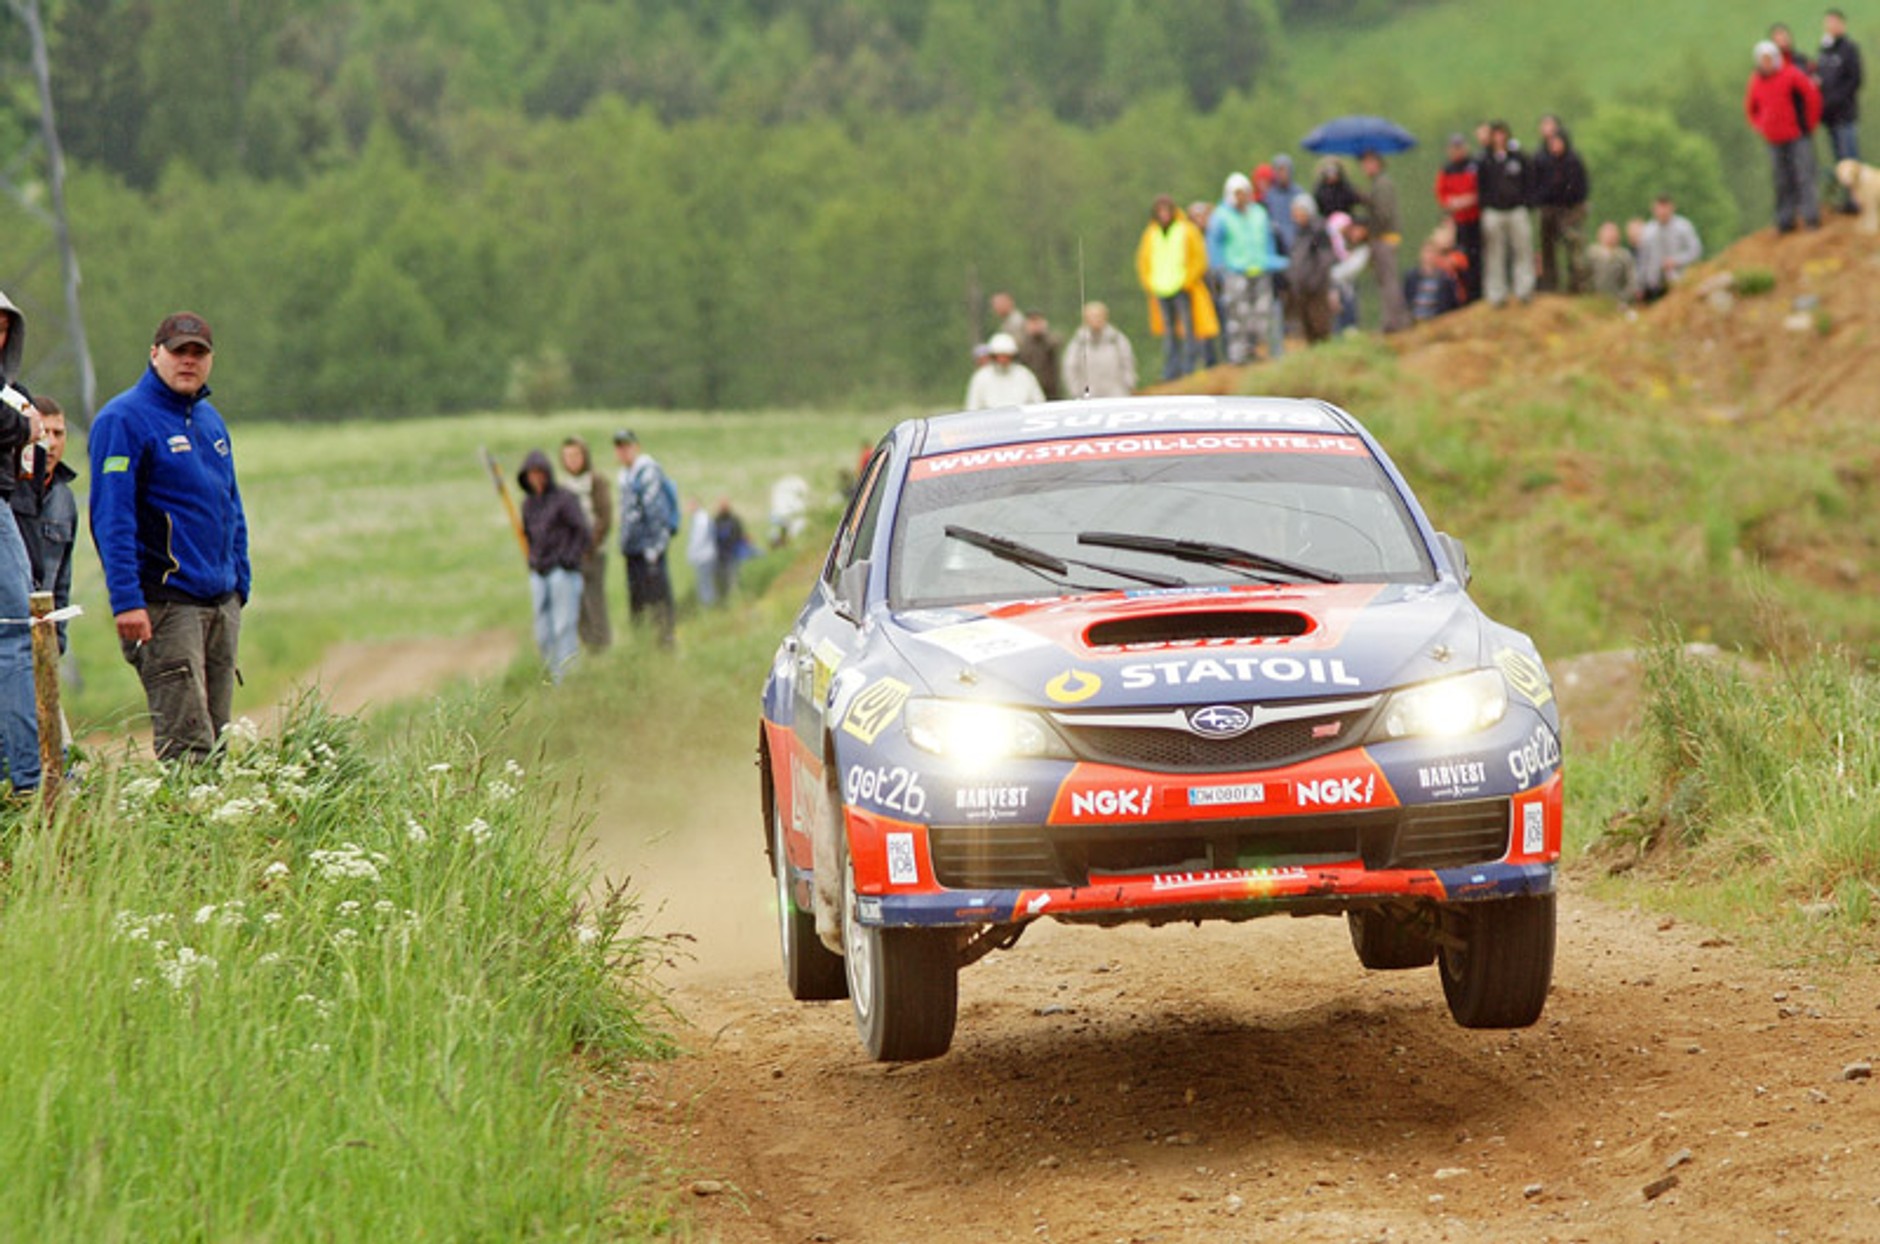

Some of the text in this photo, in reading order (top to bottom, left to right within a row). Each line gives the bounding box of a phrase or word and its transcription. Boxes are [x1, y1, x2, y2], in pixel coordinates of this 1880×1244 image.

[1119, 657, 1361, 689] STATOIL
[1418, 762, 1486, 788] HARVEST
[956, 787, 1029, 808] HARVEST
[1071, 787, 1140, 817] NGK
[1296, 776, 1364, 806] NGK
